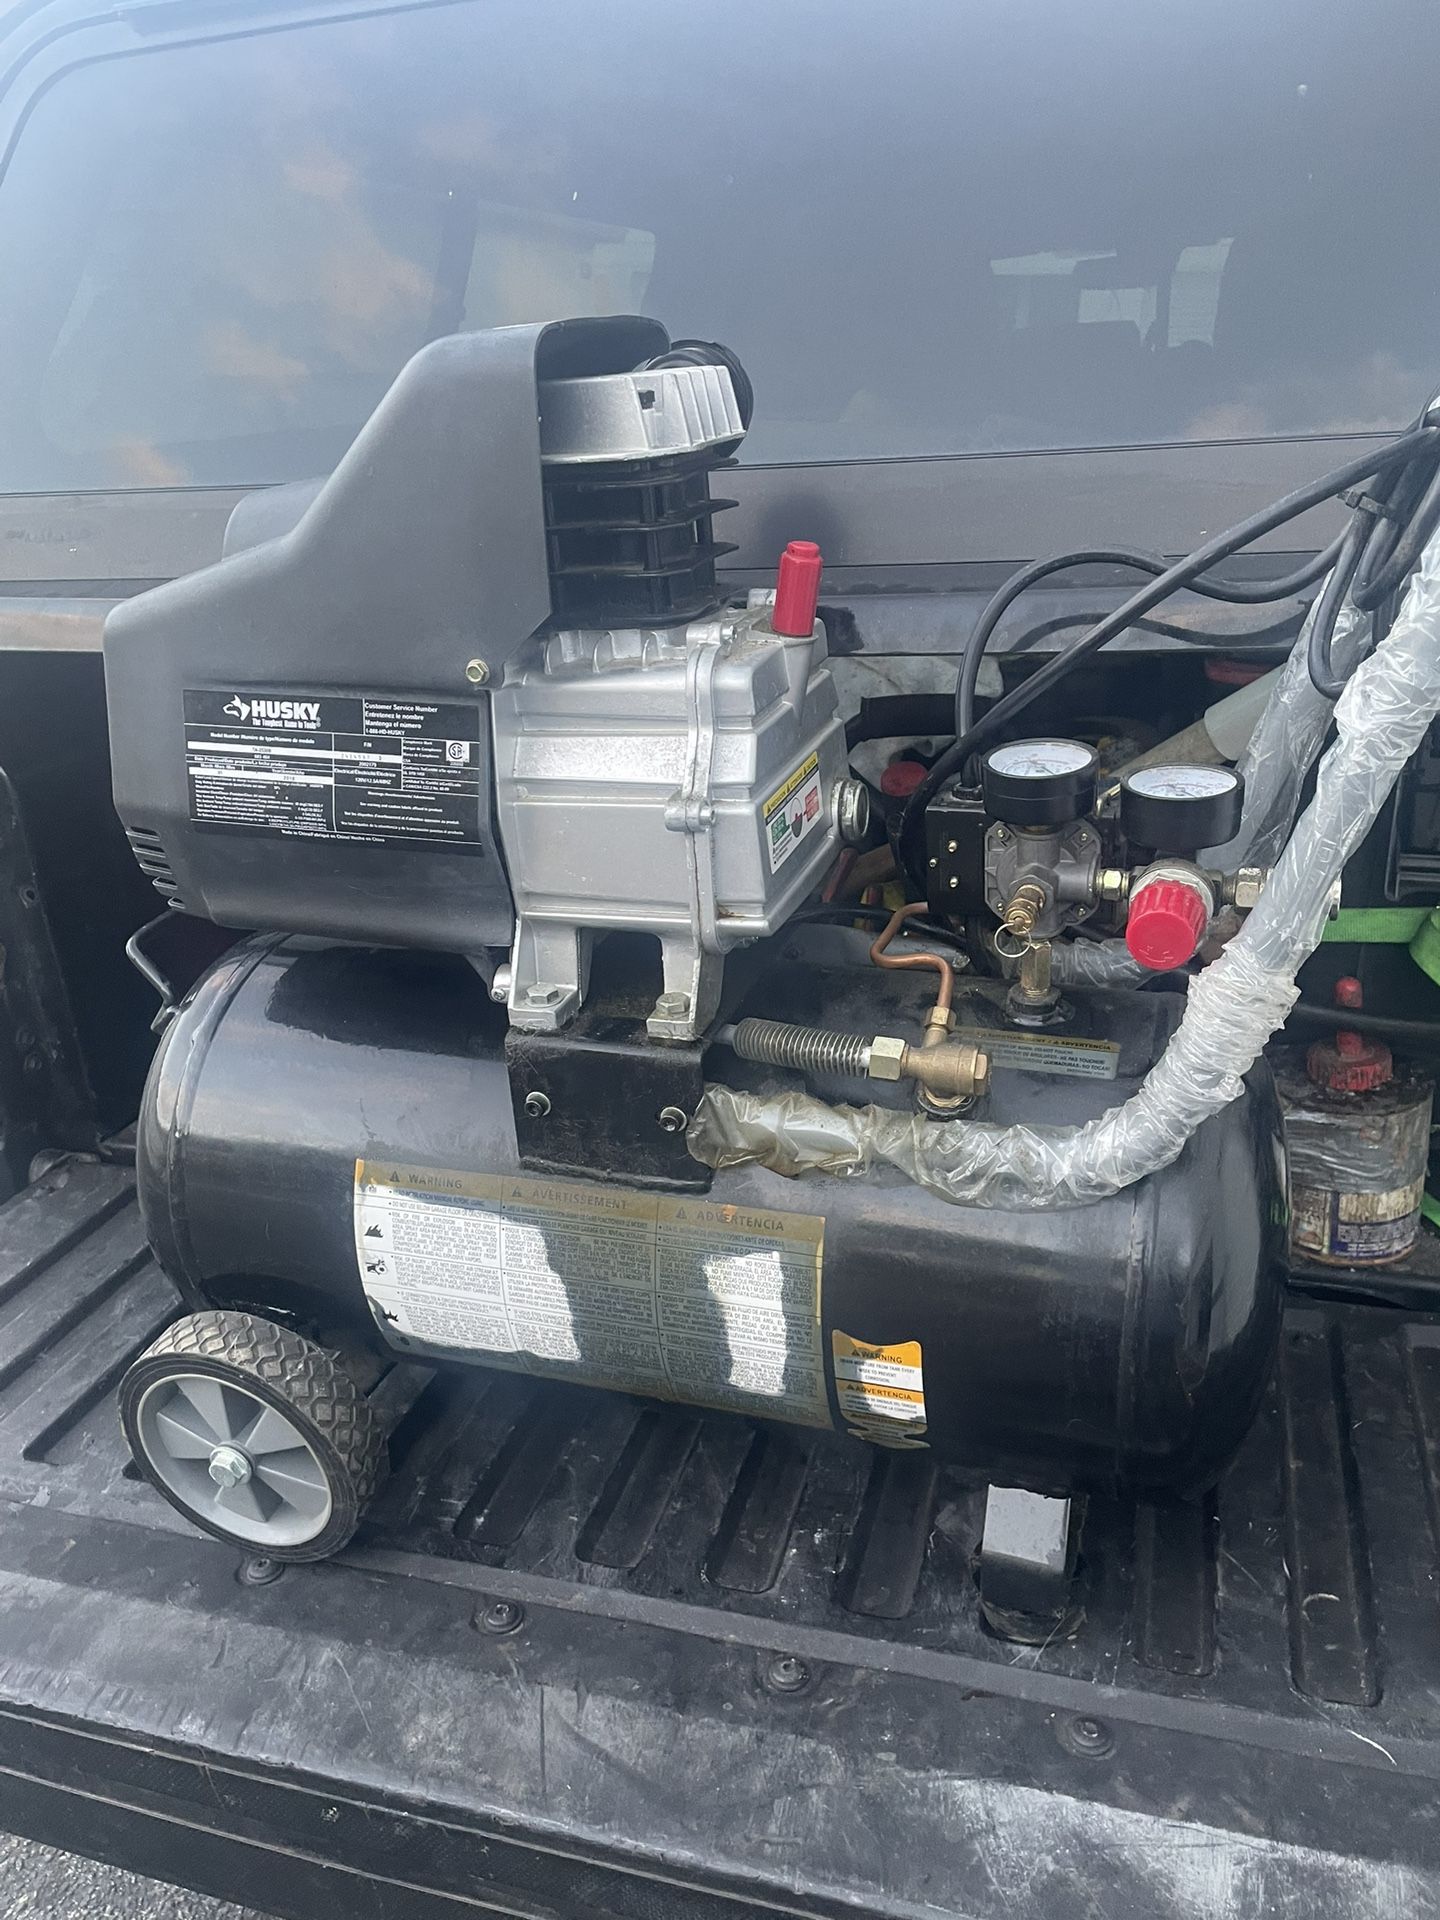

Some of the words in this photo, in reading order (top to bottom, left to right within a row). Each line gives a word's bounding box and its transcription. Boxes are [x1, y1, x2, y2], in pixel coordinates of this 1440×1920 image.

[251, 700, 320, 720] HUSKY
[366, 720, 392, 728] Mantenga
[408, 1174, 462, 1189] WARNING
[532, 1188, 627, 1210] AVERTISSEMENT
[697, 1211, 784, 1231] ADVERTENCIA
[861, 1351, 902, 1364] WARNING
[856, 1385, 912, 1400] ADVERTENCIA
